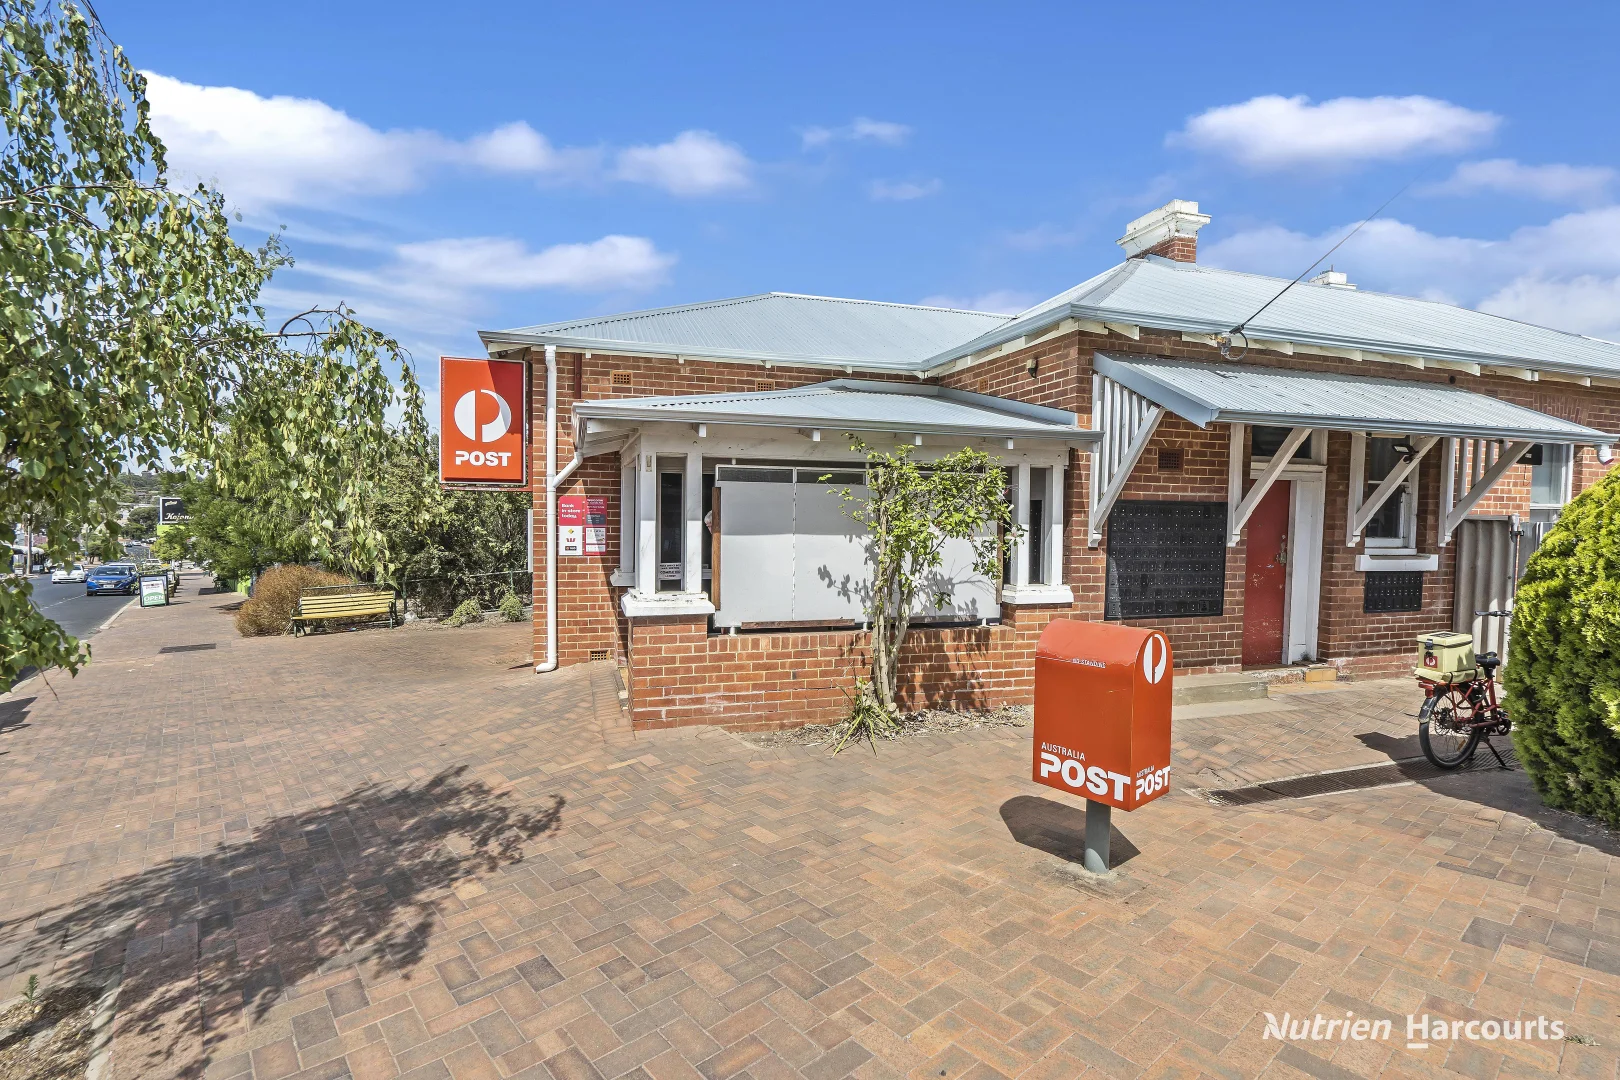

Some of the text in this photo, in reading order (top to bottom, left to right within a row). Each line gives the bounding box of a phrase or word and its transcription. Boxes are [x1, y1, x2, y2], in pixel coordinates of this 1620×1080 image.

[455, 451, 512, 467] POST
[1041, 742, 1085, 761] AUSTRALIA
[1041, 753, 1131, 801] POST
[1135, 765, 1170, 801] POST
